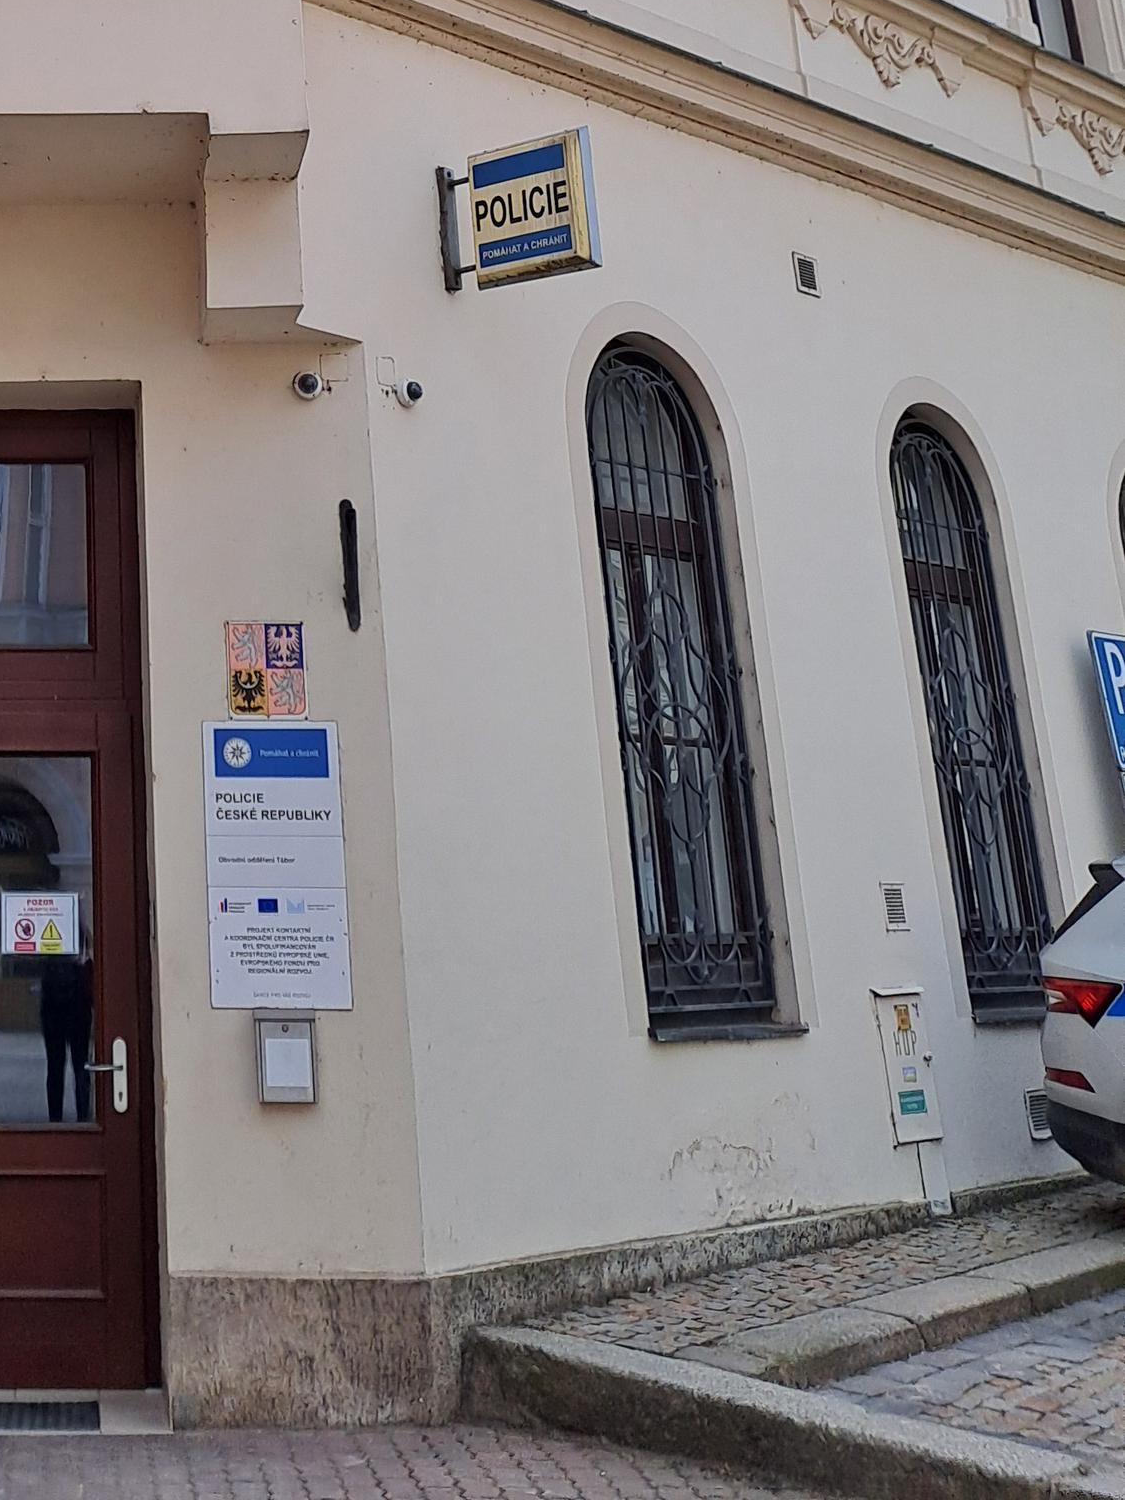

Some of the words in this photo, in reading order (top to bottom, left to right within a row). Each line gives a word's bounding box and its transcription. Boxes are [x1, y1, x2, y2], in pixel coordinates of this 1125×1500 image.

[475, 180, 569, 232] POLICIE
[482, 243, 522, 260] POMÁHAT
[523, 242, 530, 251] A
[530, 233, 568, 249] CHRÁNIT
[1104, 641, 1125, 715] P
[215, 792, 264, 803] POLICIE
[216, 807, 258, 820] ČESKÉ
[261, 809, 331, 821] REPUBLIKY
[893, 1030, 917, 1056] HUP
